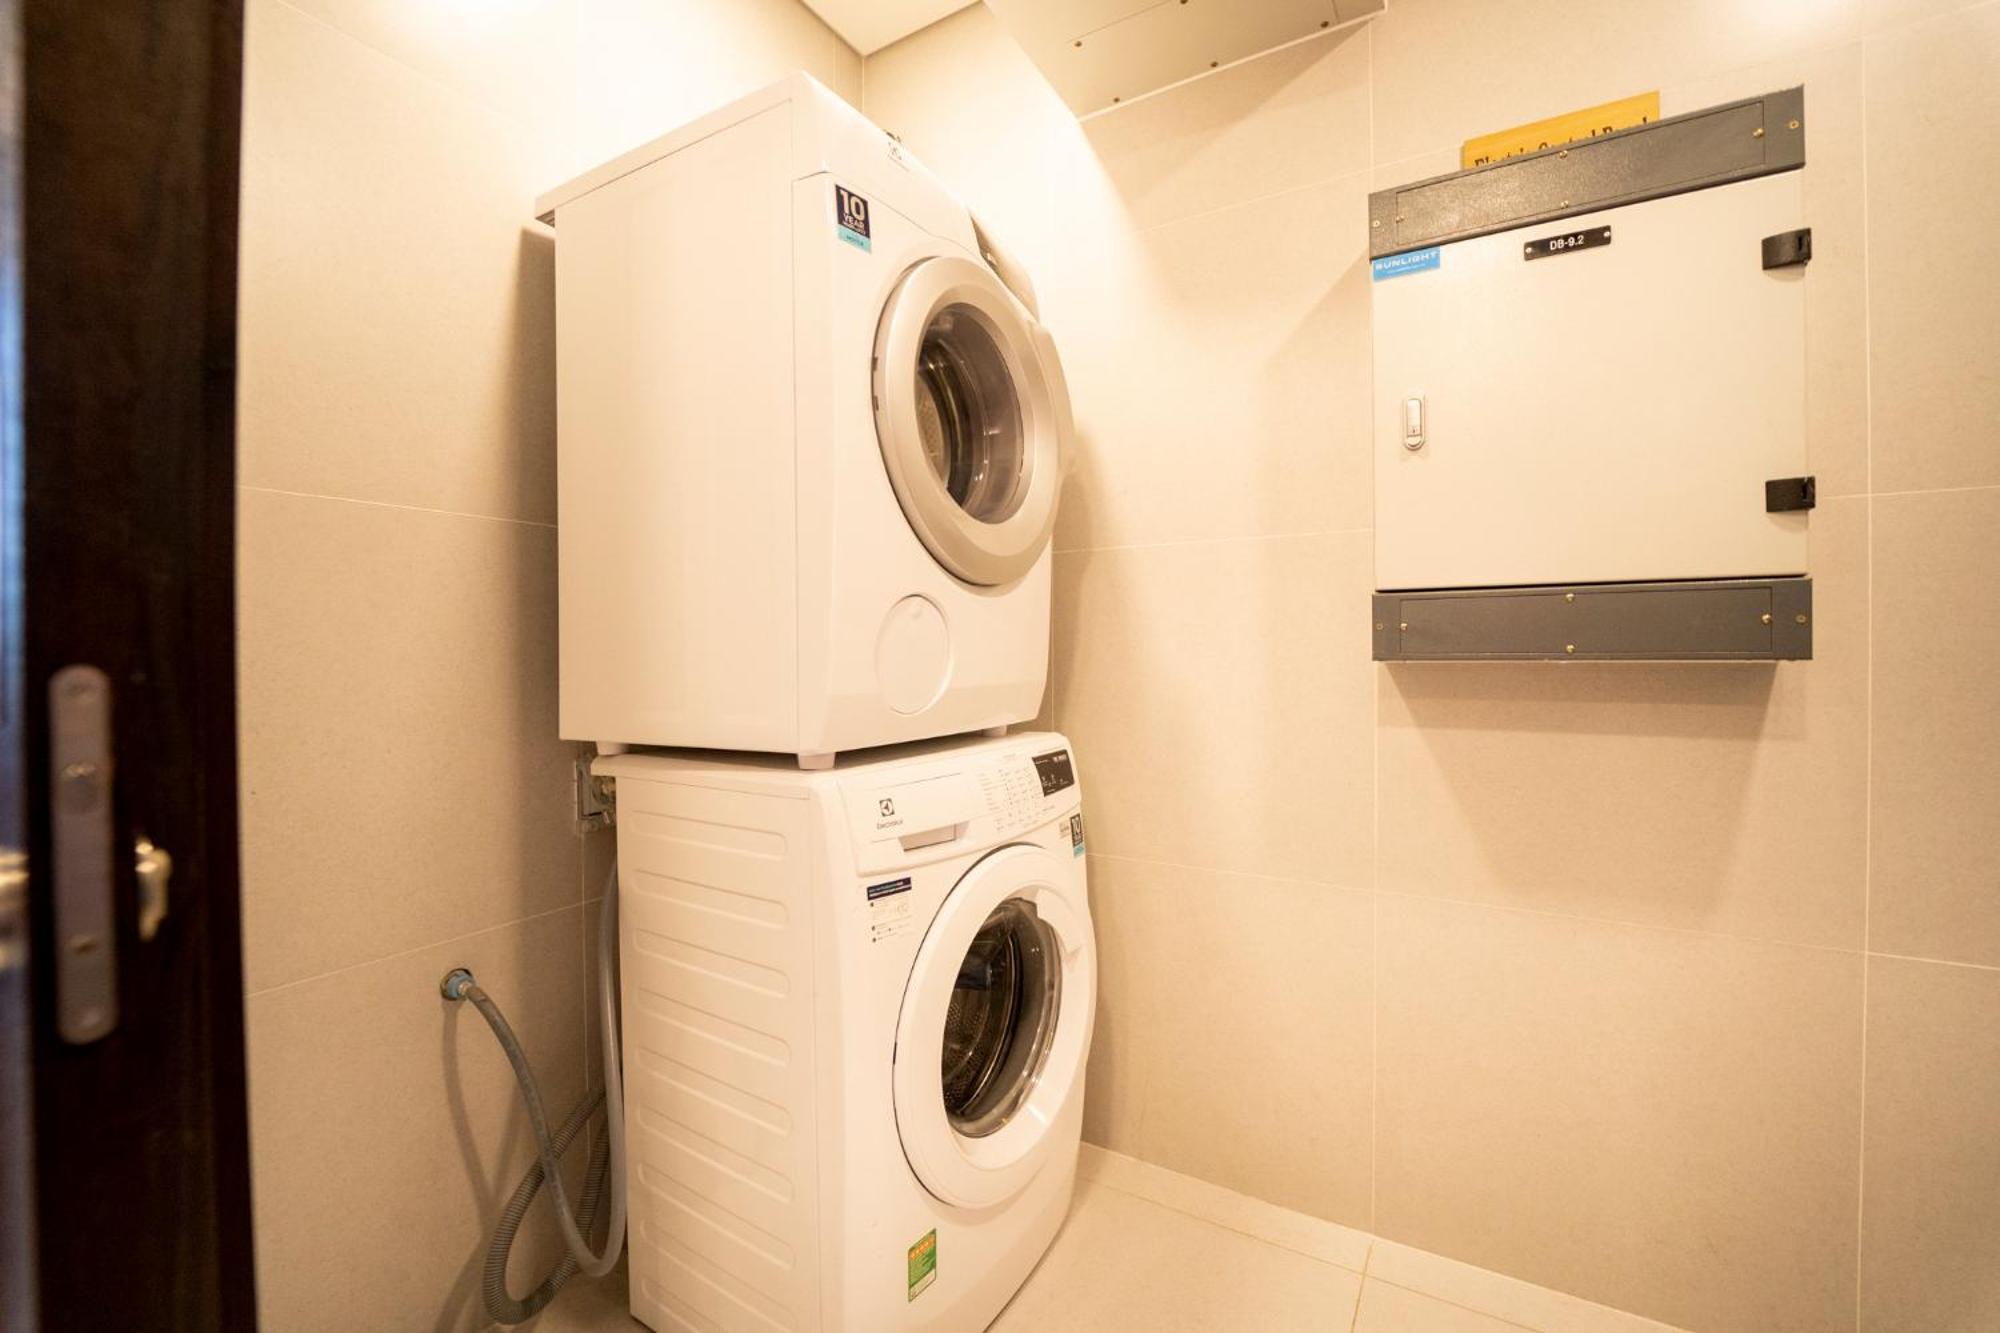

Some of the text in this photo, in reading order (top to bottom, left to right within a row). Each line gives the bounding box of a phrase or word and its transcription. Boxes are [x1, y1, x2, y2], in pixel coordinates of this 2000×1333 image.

[840, 189, 865, 221] 10
[1550, 234, 1584, 250] DB-9.2
[1375, 250, 1438, 269] SUNLIGHT
